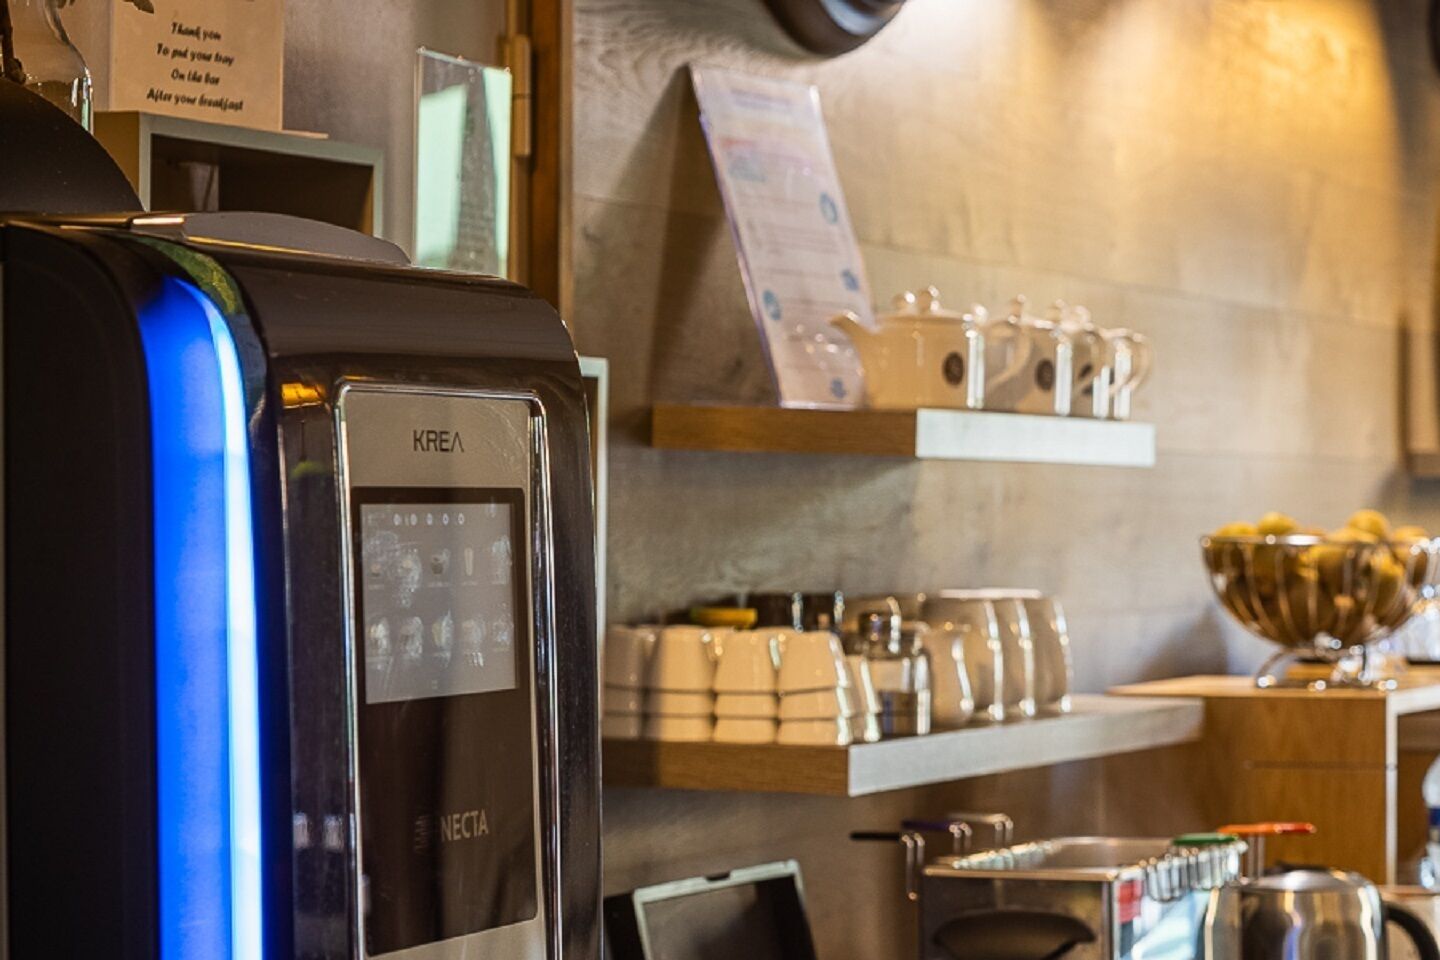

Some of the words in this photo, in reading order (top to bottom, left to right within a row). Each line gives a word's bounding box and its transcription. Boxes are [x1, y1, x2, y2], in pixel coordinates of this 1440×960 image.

[171, 22, 201, 40] Thank
[202, 29, 221, 41] you
[157, 43, 169, 56] To
[171, 47, 188, 59] put
[190, 51, 212, 62] your
[214, 52, 235, 66] tray
[171, 68, 185, 80] On
[187, 70, 202, 83] the
[204, 72, 220, 85] bar
[146, 88, 172, 102] After
[174, 94, 197, 105] your
[198, 94, 244, 111] breakfast
[413, 429, 464, 453] KREA
[441, 809, 489, 842] NECTA
